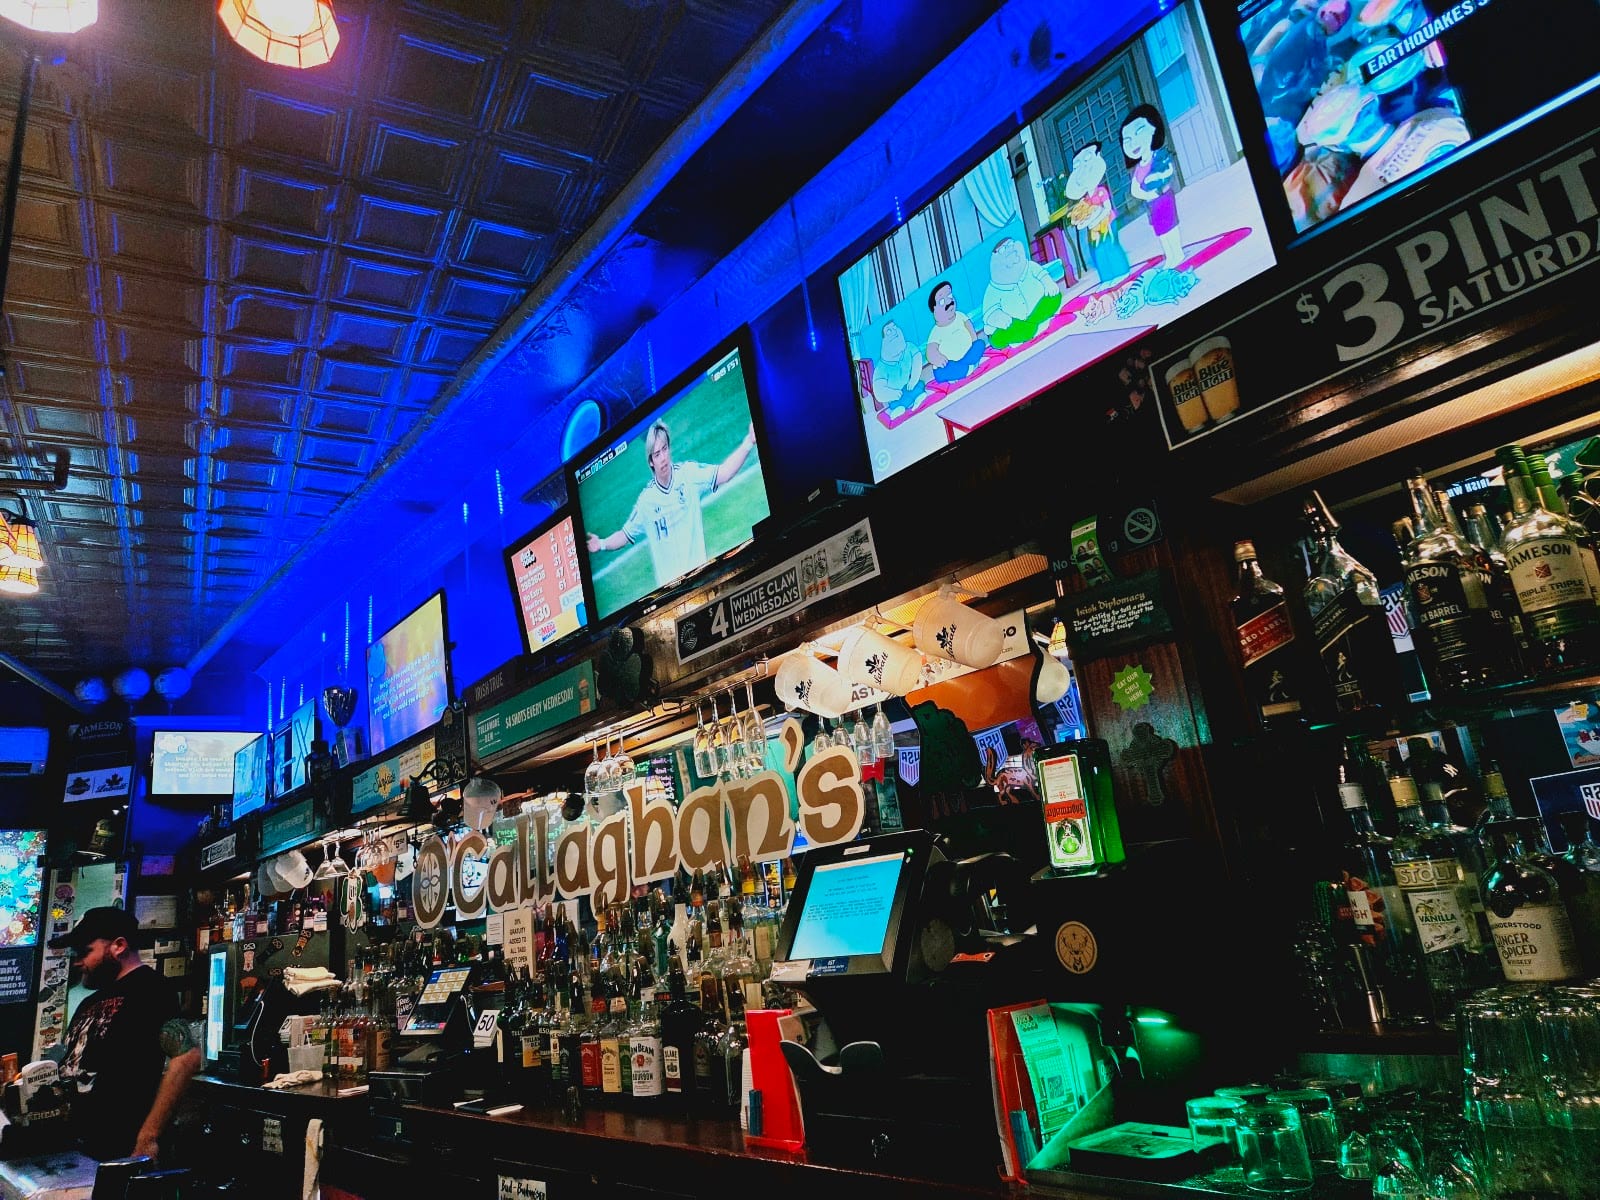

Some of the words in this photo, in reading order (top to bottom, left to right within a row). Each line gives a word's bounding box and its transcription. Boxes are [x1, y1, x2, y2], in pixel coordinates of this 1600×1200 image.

[1367, 1, 1475, 76] EARTHQUAKES
[1418, 218, 1600, 329] SATURD
[1200, 357, 1230, 379] Blue
[1201, 370, 1233, 391] LIGHT
[654, 516, 668, 540] 14
[1507, 543, 1572, 570] JAMESON
[1407, 565, 1450, 585] MESON
[733, 589, 765, 612] WHITE
[767, 571, 796, 596] CLAW
[529, 604, 552, 626] 1:30
[734, 586, 800, 627] WEDNESDAYS
[1428, 604, 1463, 621] BARREL
[1240, 633, 1258, 646] RED
[526, 699, 543, 721] EVERY
[542, 686, 574, 713] WEDNESDAY
[1399, 865, 1451, 885] STOLI
[1420, 912, 1458, 923] VANILLA
[478, 1014, 495, 1032] 50
